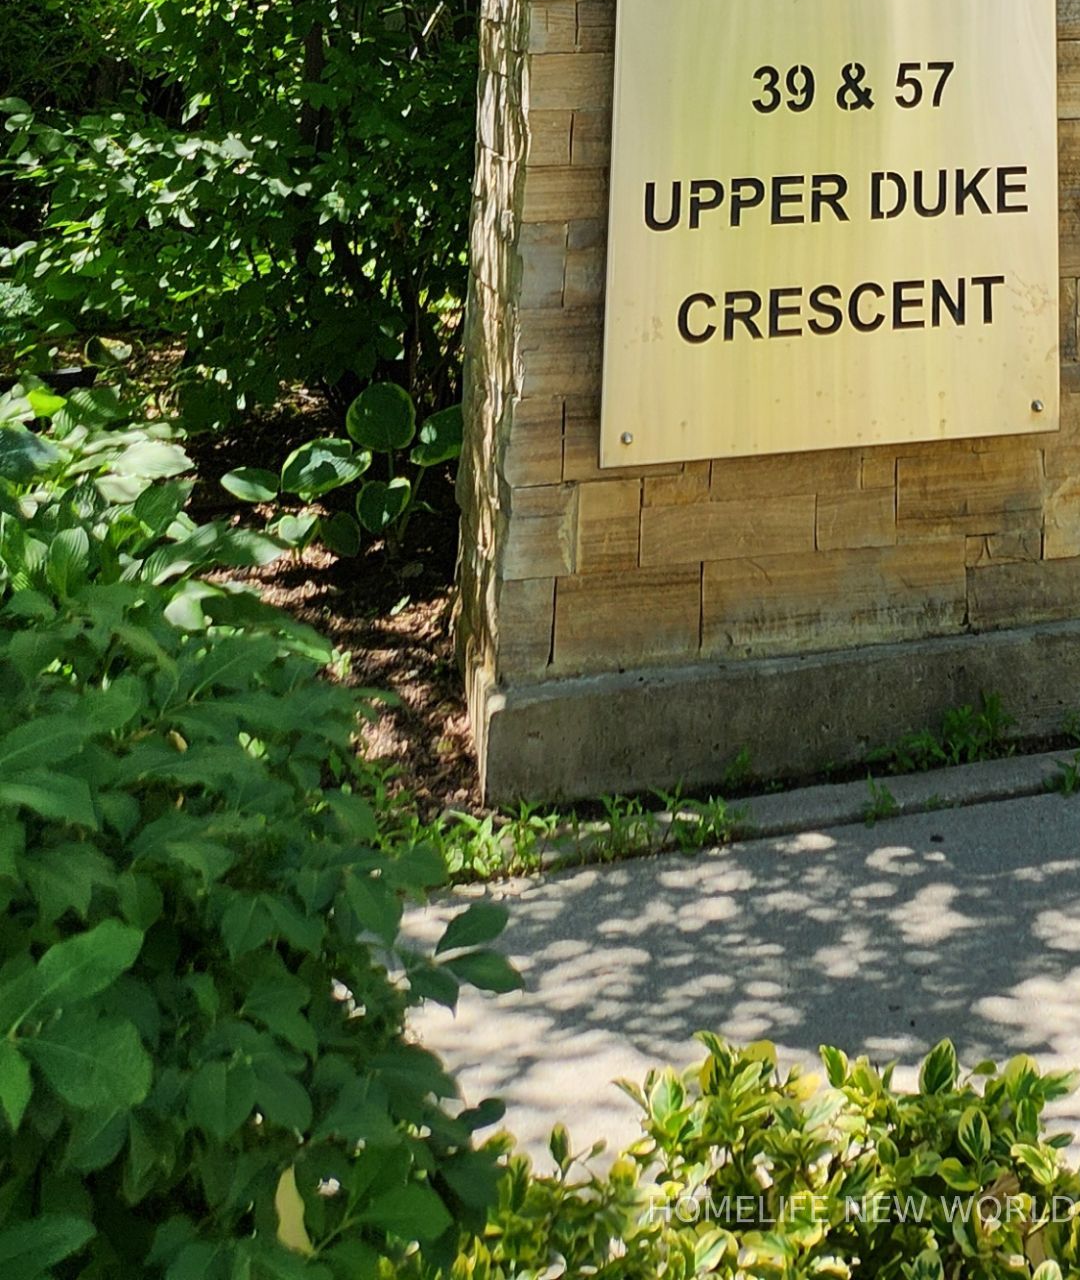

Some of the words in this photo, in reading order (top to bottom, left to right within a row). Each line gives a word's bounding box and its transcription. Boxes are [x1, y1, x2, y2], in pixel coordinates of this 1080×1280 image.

[752, 64, 815, 114] 39
[836, 62, 875, 111] &
[894, 61, 955, 108] 57
[644, 174, 849, 232] UPPER
[871, 166, 1028, 220] DUKE
[677, 276, 1005, 344] CRESCENT
